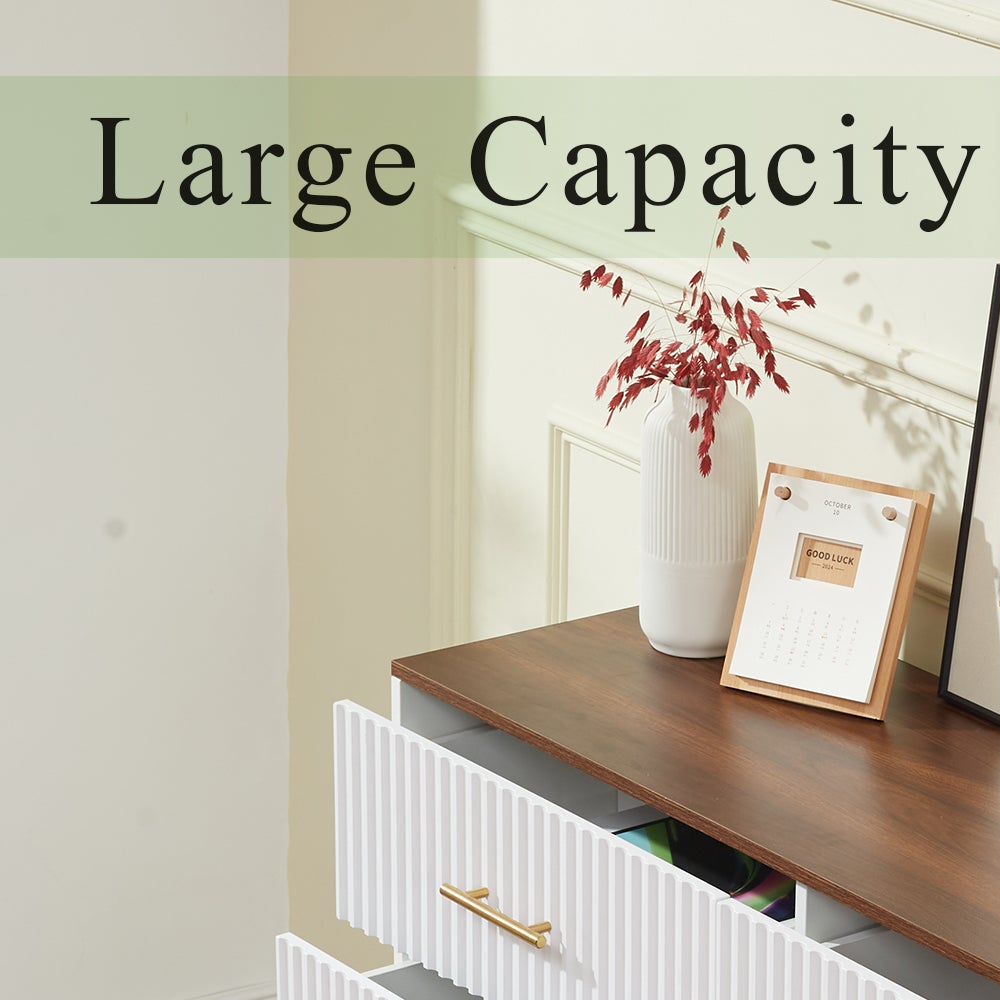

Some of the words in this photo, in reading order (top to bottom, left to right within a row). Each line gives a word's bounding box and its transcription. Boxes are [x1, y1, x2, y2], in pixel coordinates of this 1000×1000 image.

[823, 500, 852, 510] OCTOBER
[806, 548, 831, 561] GOOD
[831, 553, 855, 566] LUCK
